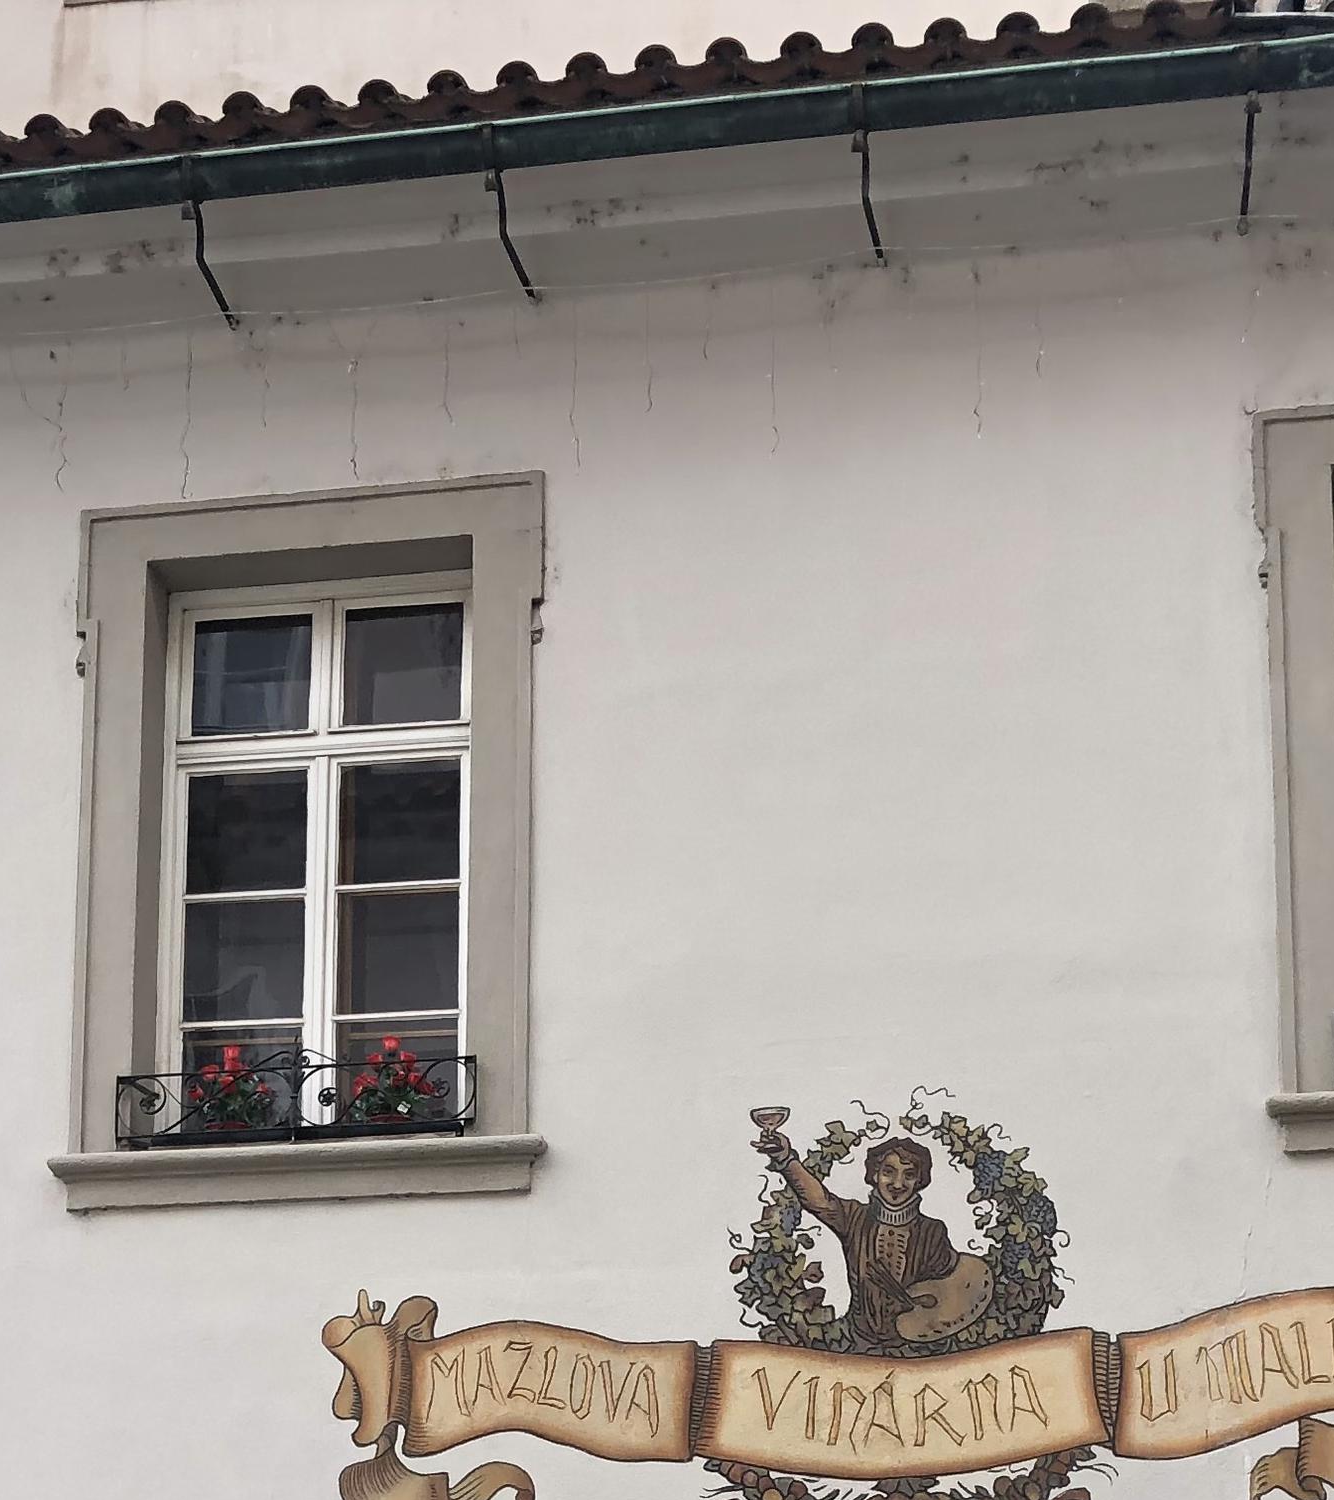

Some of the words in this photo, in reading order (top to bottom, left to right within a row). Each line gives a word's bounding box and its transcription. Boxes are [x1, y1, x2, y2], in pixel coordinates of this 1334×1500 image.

[425, 1340, 660, 1438] MAZLOVA
[751, 1364, 1049, 1455] VINÁRNA
[1136, 1349, 1177, 1422] U
